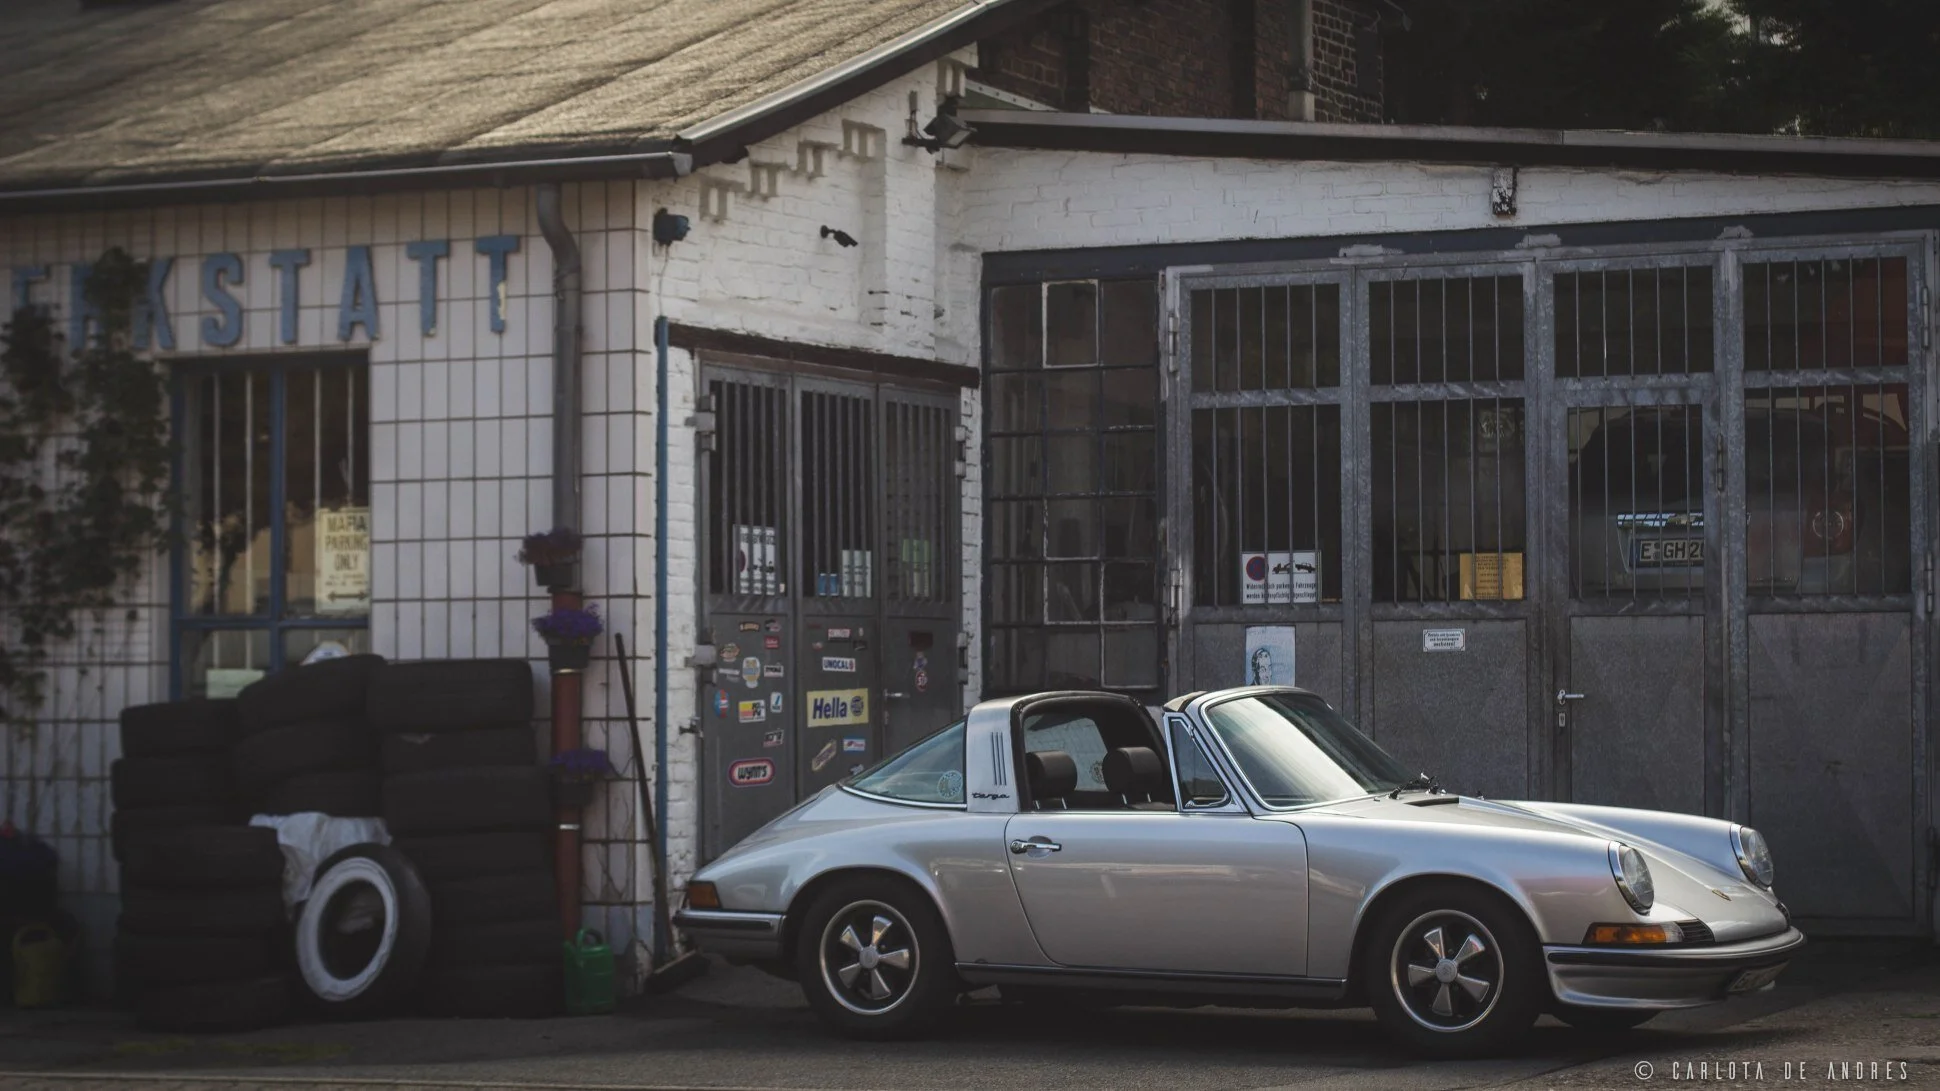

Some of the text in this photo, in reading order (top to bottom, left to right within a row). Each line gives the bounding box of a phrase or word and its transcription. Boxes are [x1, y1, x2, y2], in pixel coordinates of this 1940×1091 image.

[326, 515, 366, 532] MAFIA
[324, 534, 367, 552] PARKING
[334, 553, 358, 571] ONLY
[824, 659, 849, 670] UNOCAL
[812, 697, 848, 720] Hella
